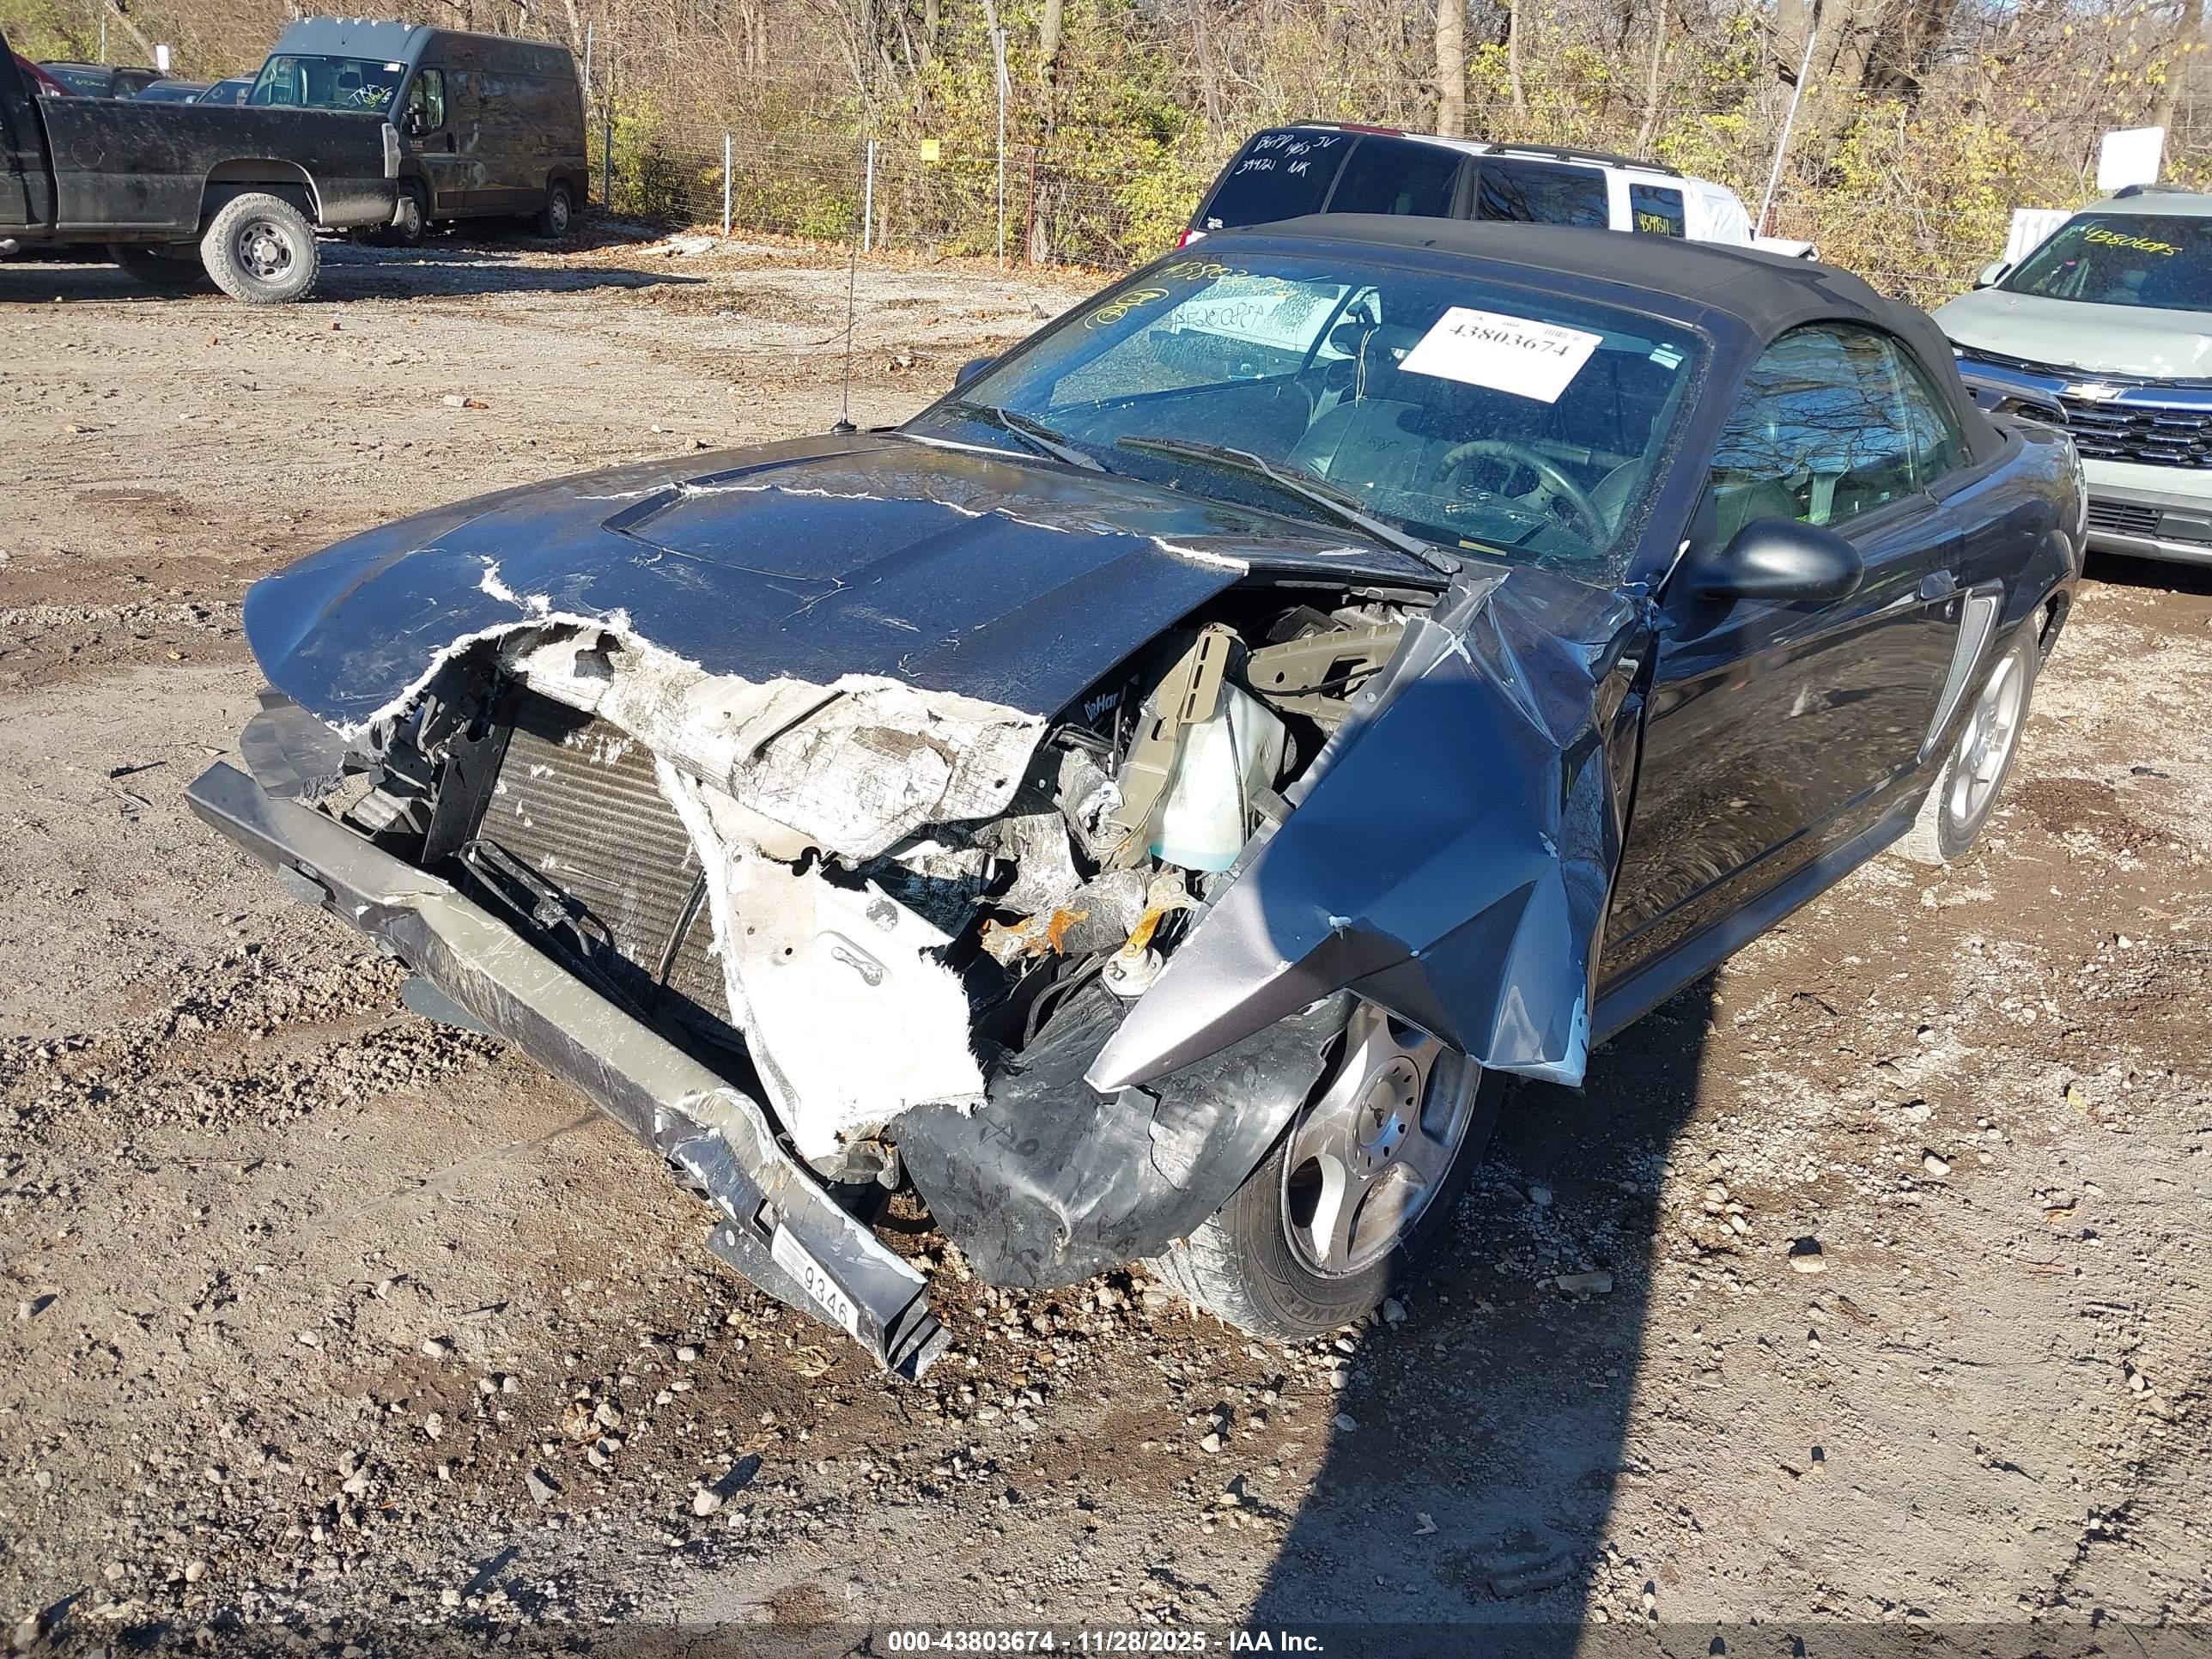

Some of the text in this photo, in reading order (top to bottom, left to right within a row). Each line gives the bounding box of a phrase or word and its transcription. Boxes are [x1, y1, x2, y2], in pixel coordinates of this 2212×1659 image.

[1449, 324, 1570, 357] 43803674
[1084, 692, 1120, 722] DieHar
[805, 1267, 848, 1324] 9346
